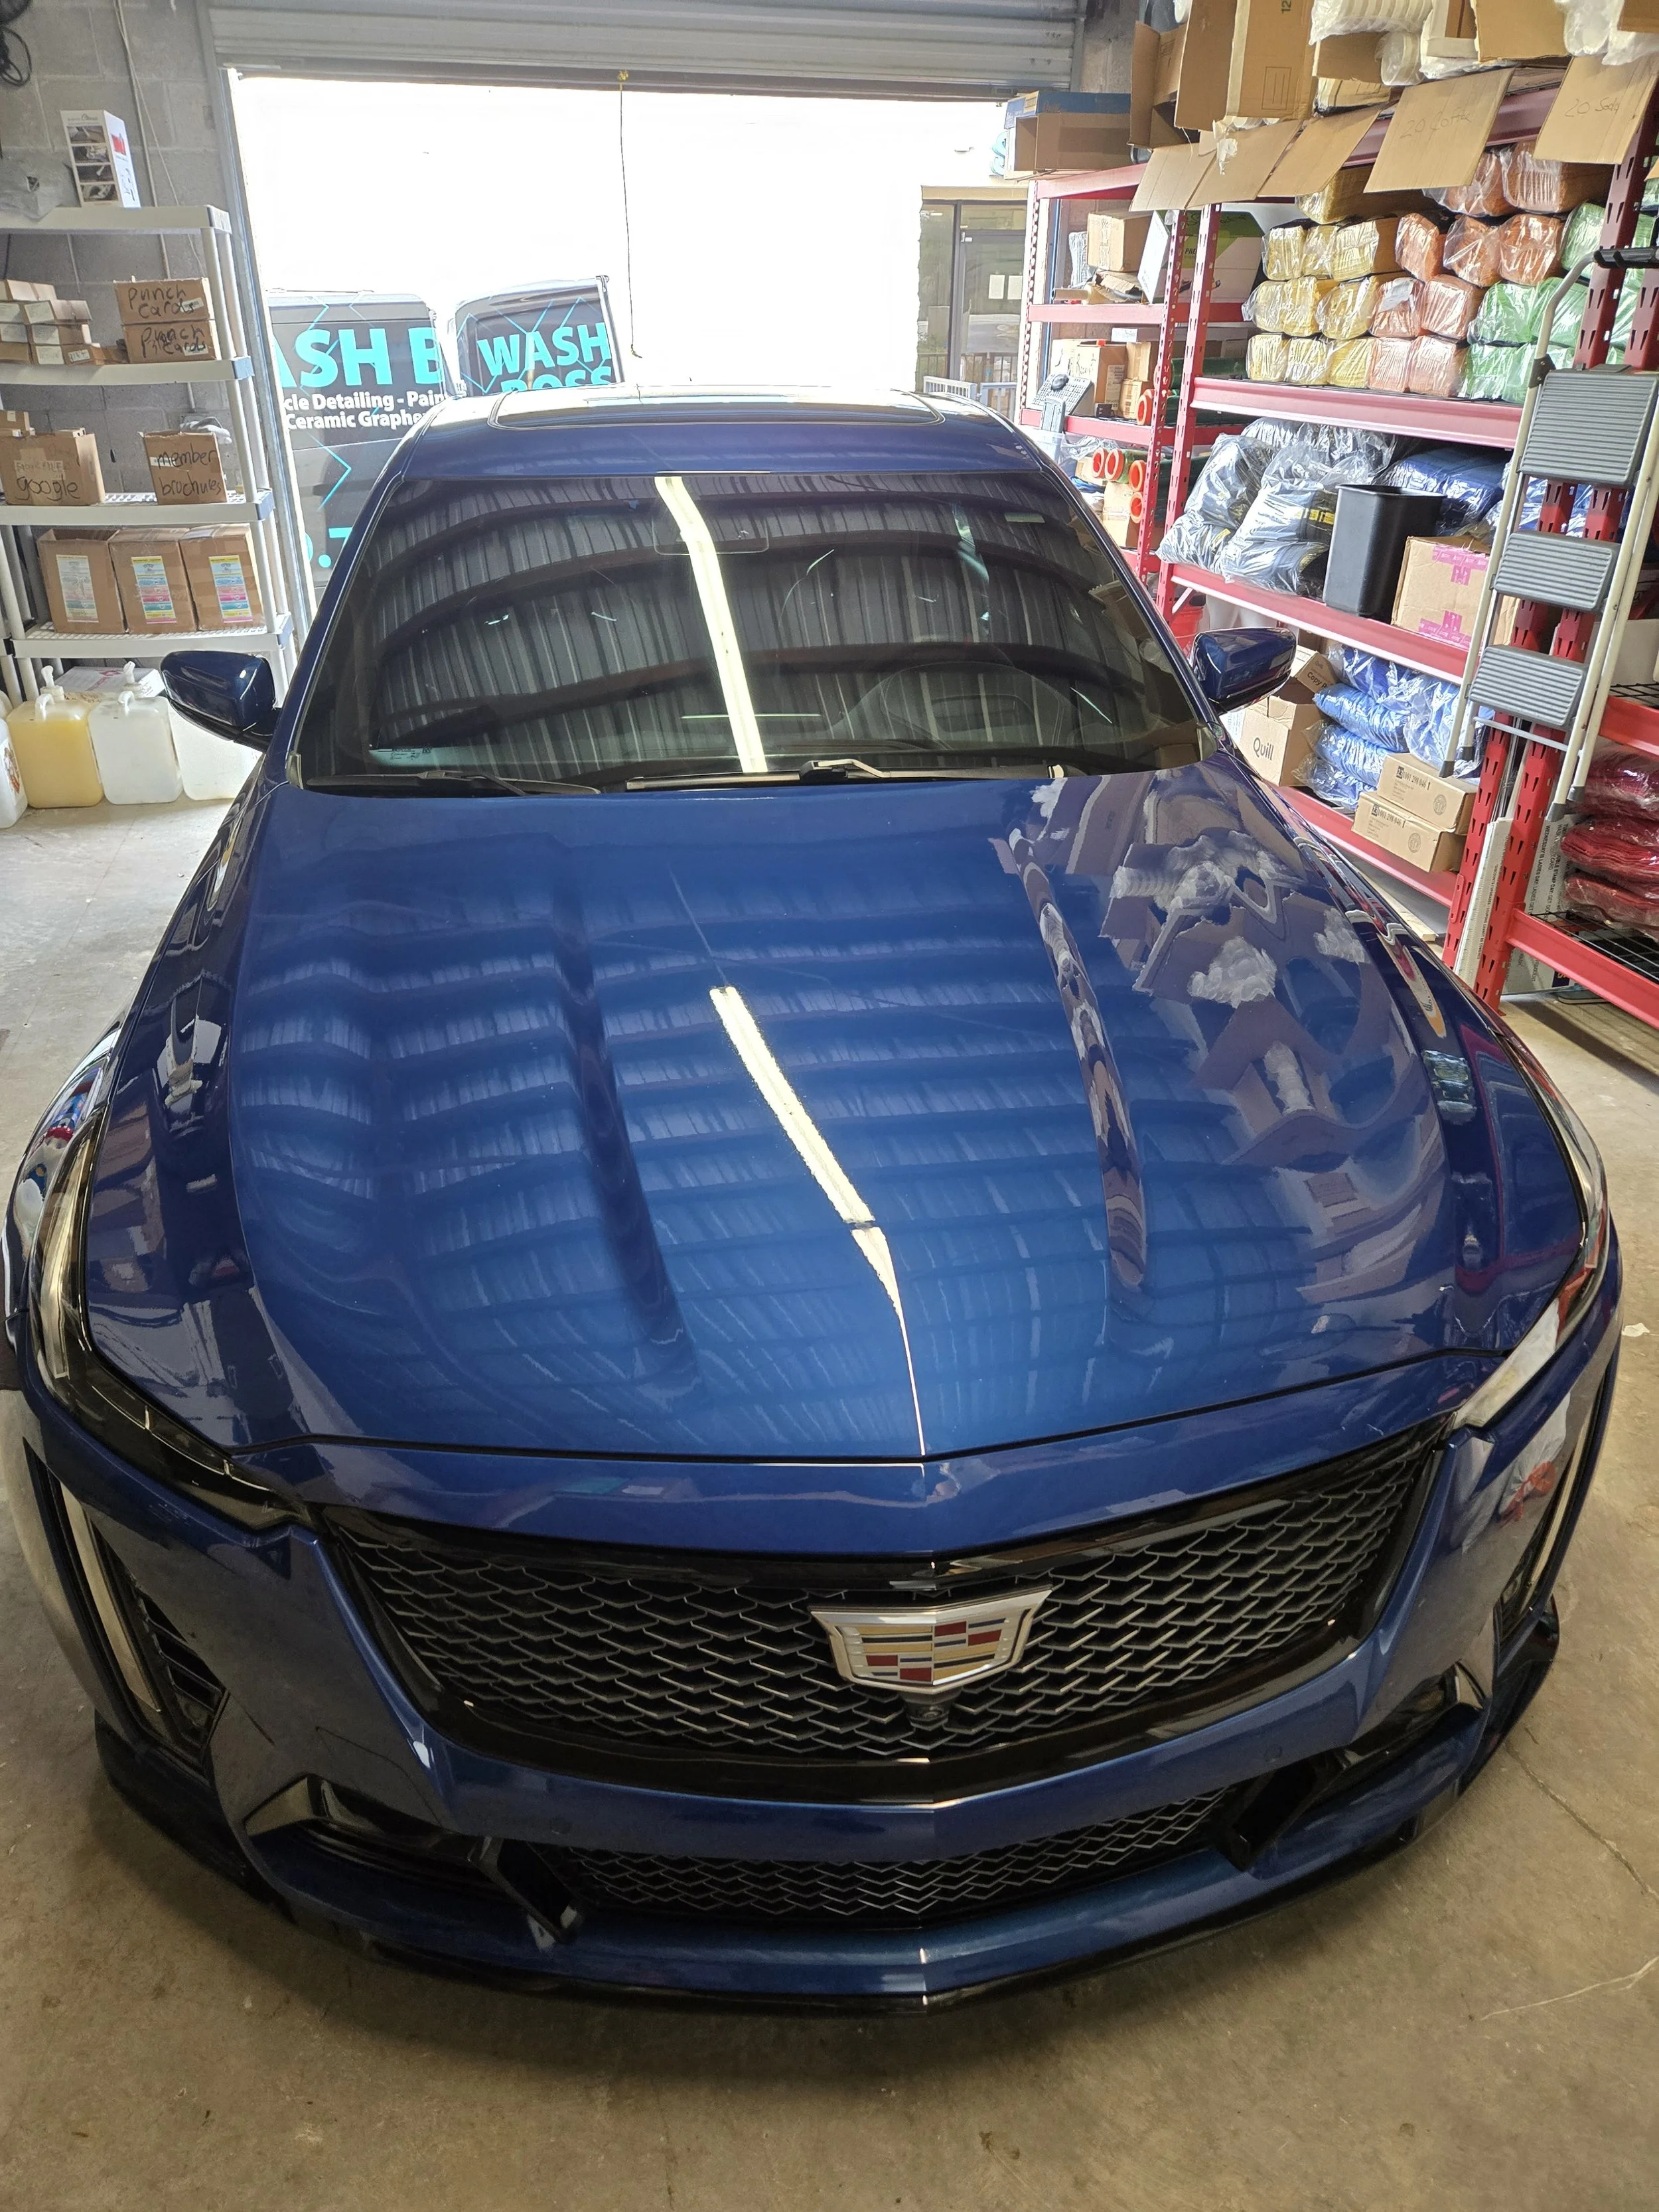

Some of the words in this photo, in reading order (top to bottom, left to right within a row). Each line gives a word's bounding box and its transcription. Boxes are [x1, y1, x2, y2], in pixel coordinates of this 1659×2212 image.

[1565, 98, 1590, 117] 20
[1400, 117, 1425, 139] 20
[477, 322, 612, 377] WASH
[311, 392, 395, 411] Detailing
[285, 411, 356, 430] Ceramic
[15, 473, 81, 500] google
[1307, 672, 1322, 686] Copy
[1253, 737, 1274, 761] Quill
[1542, 825, 1551, 853] WEDNESDAY
